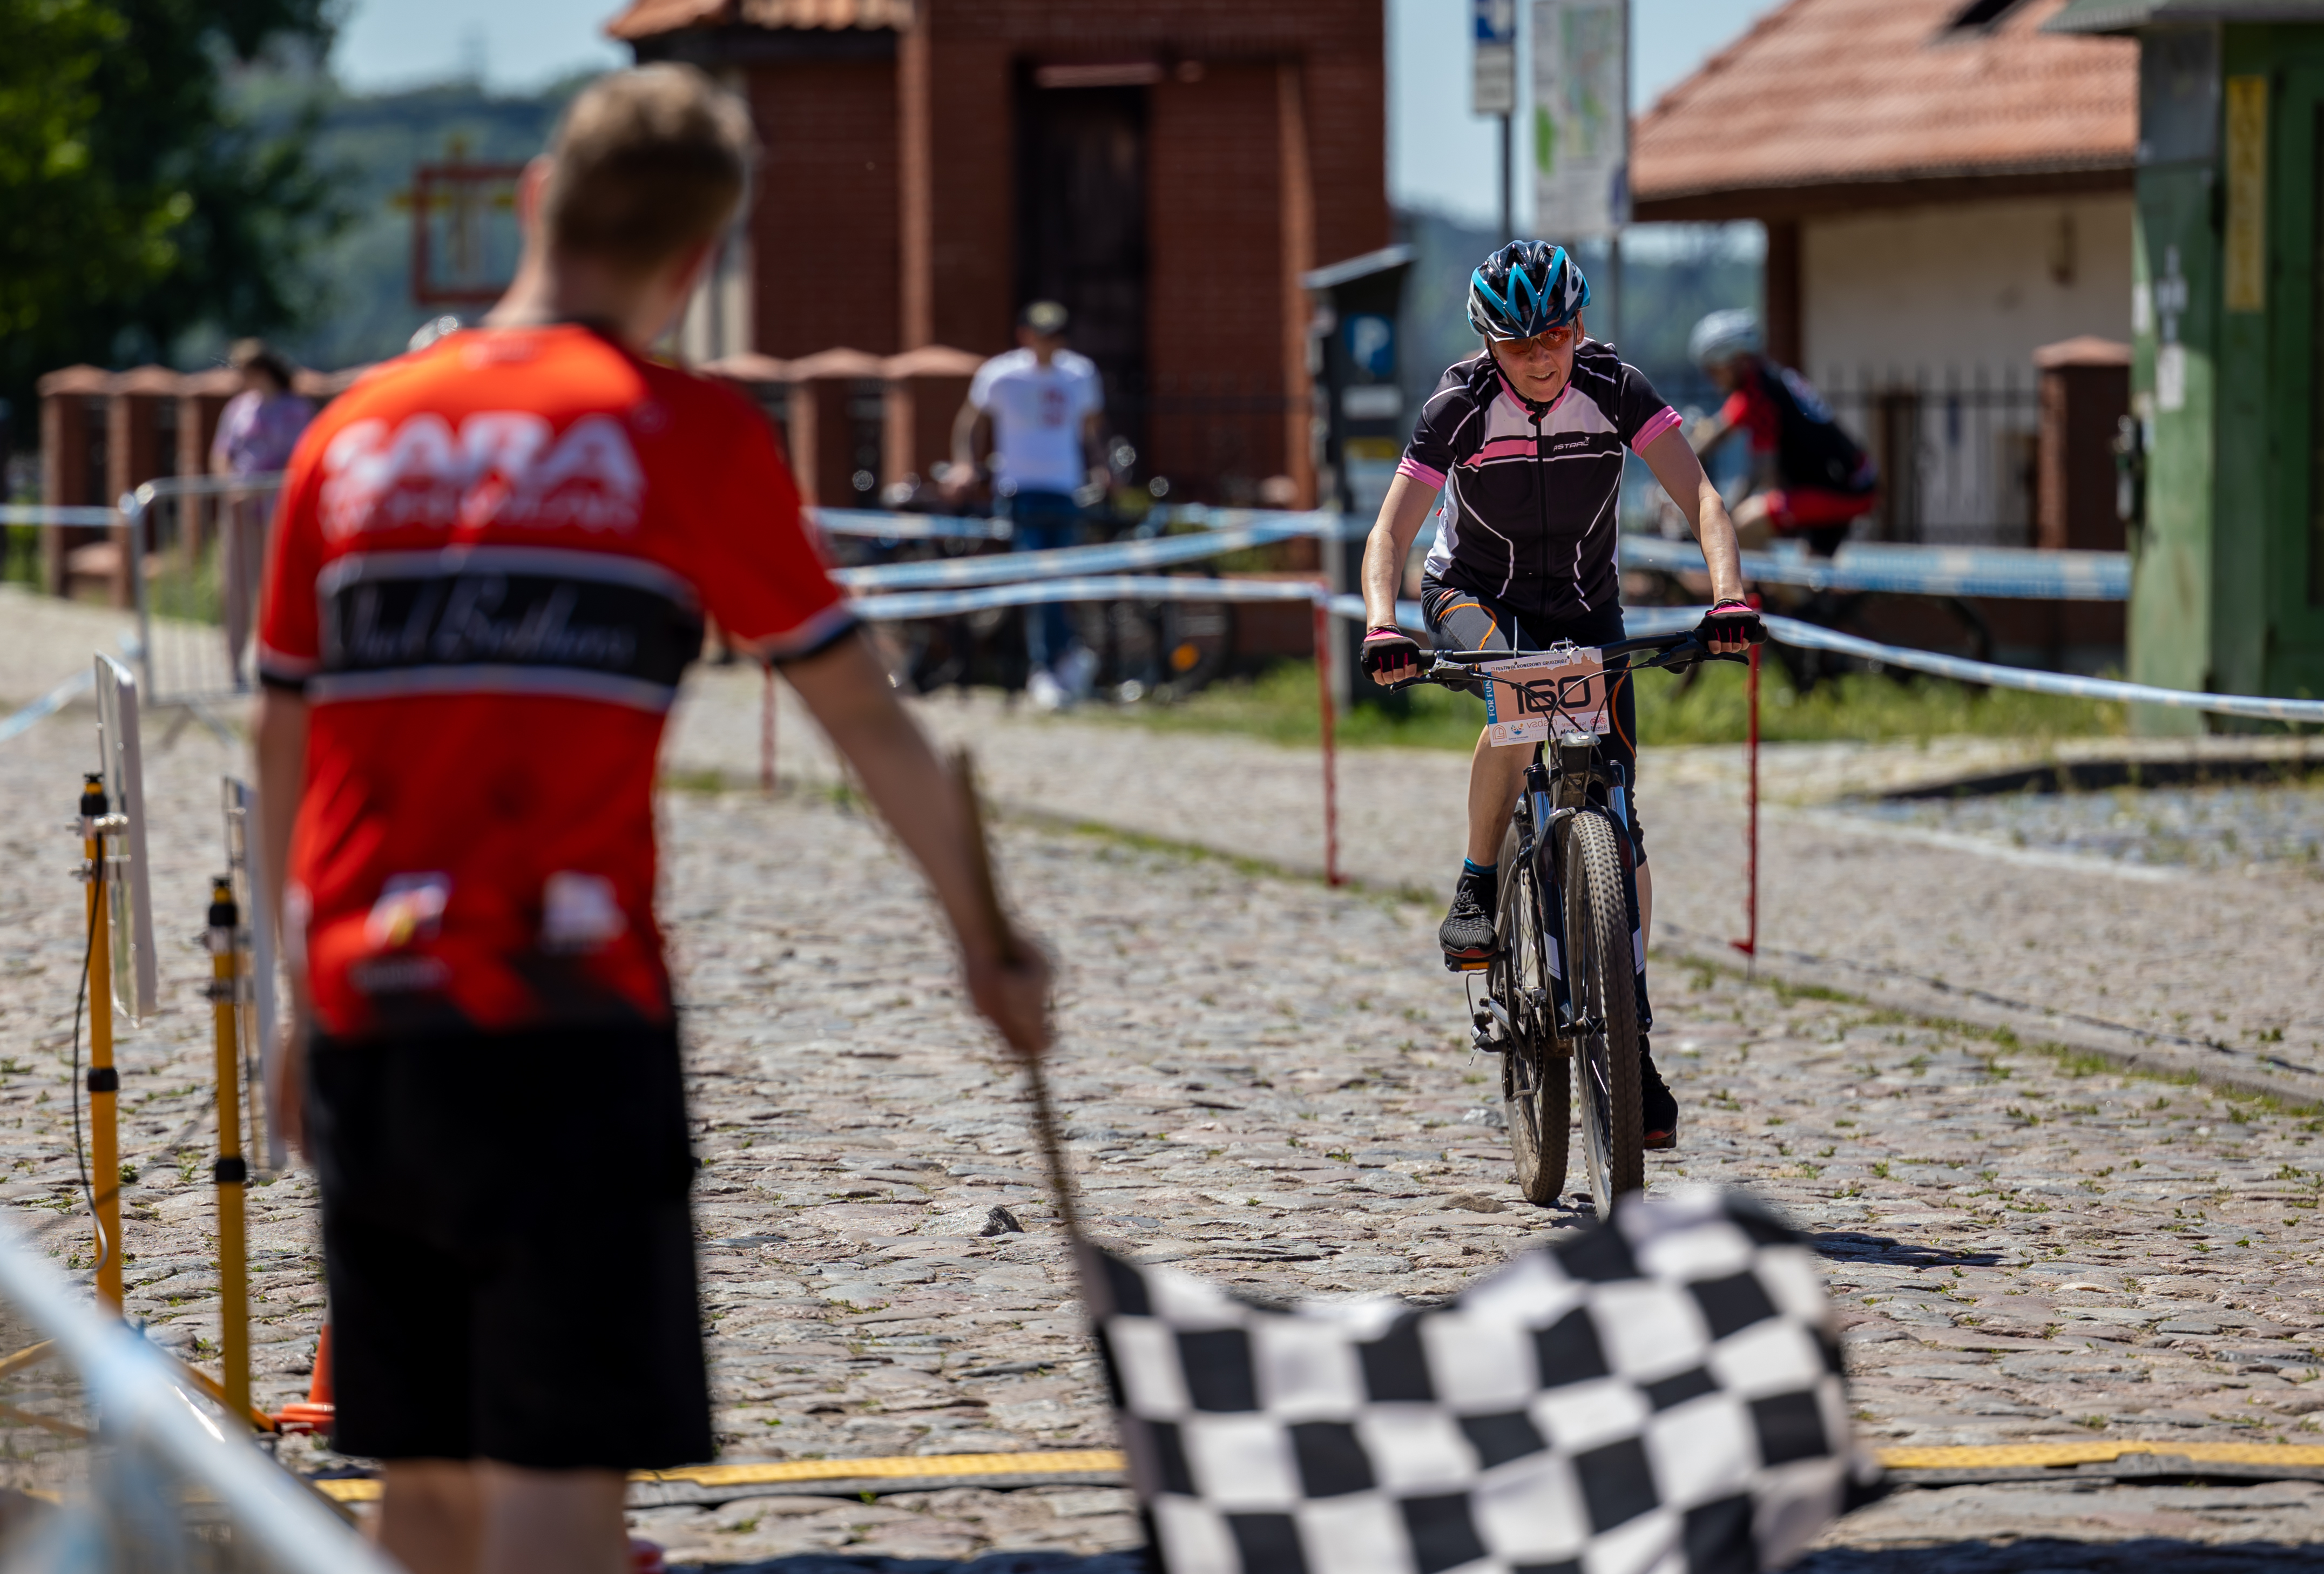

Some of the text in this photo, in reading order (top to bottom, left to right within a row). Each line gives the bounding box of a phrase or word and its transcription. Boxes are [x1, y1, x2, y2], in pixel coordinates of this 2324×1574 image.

[1553, 441, 1589, 452] ASTRAL
[1485, 679, 1495, 717] FOR FUN
[1510, 675, 1591, 714] 160
